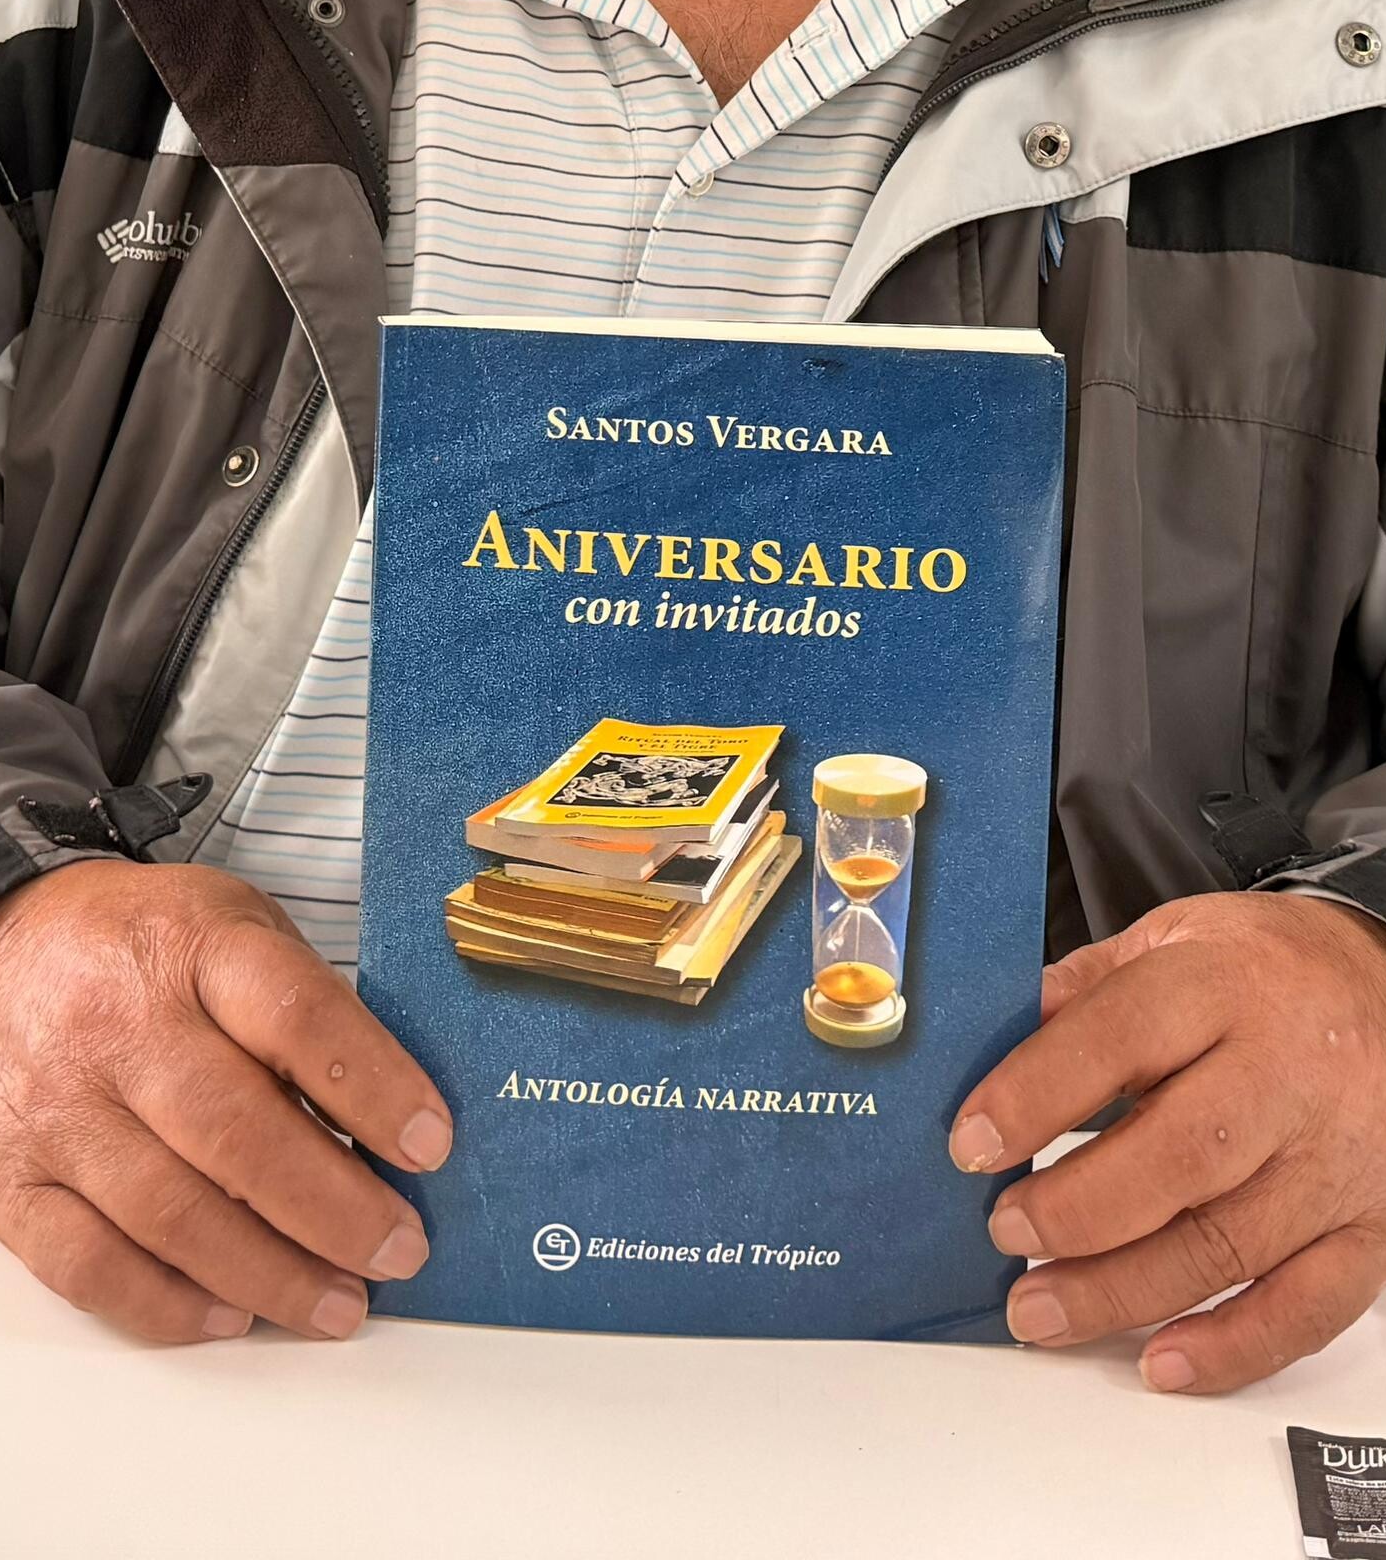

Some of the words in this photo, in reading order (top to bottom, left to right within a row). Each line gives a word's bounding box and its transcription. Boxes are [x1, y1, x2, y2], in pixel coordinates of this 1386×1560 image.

[545, 406, 695, 447] SANTOS
[706, 414, 893, 457] VERGARA
[461, 508, 968, 594] ANIVERSARIO
[564, 593, 641, 628] con
[653, 590, 863, 639] invitados
[496, 1070, 685, 1109] ANTOLOGÍA
[694, 1086, 878, 1116] NARRATIVA
[586, 1236, 701, 1264] Ediciones
[705, 1241, 743, 1265] del
[750, 1243, 842, 1271] Trópico
